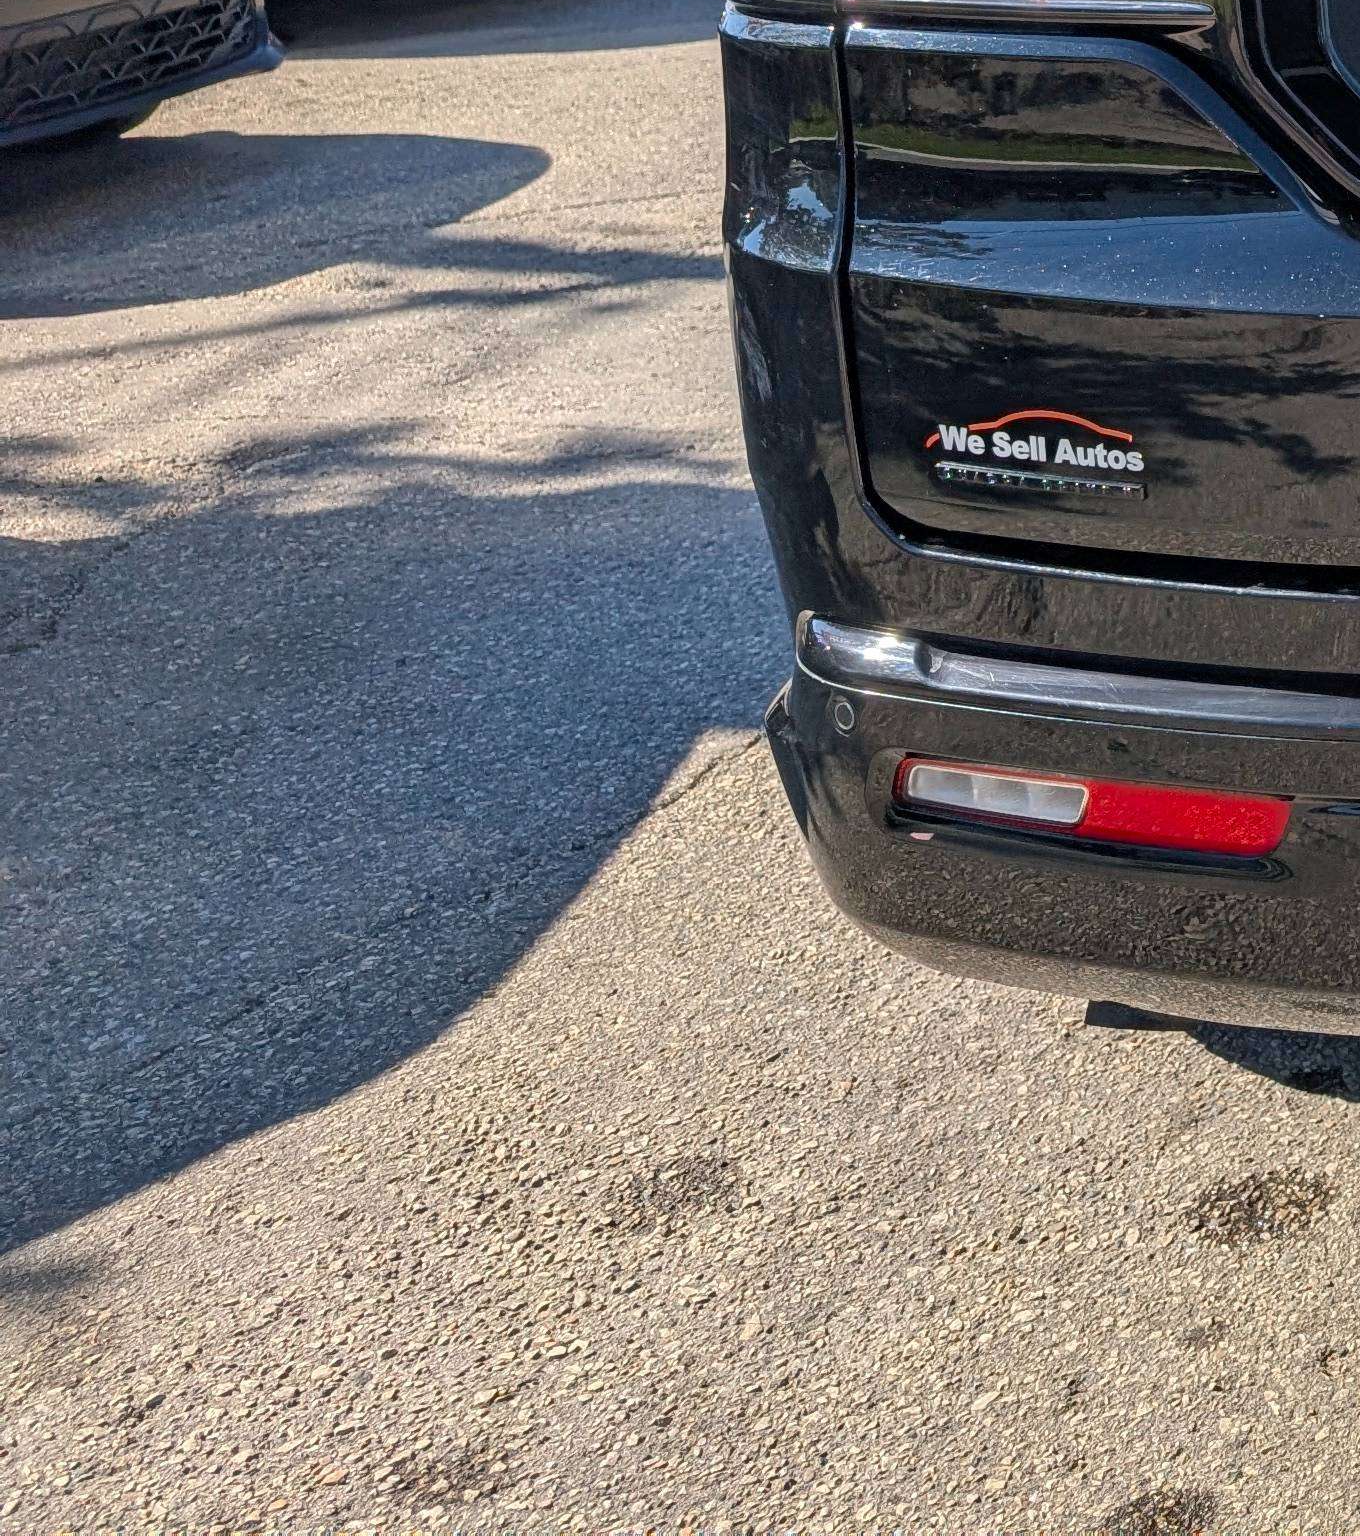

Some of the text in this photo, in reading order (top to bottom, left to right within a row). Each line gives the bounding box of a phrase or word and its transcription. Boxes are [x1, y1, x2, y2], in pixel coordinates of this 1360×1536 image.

[938, 424, 1145, 472] We Sell Autos
